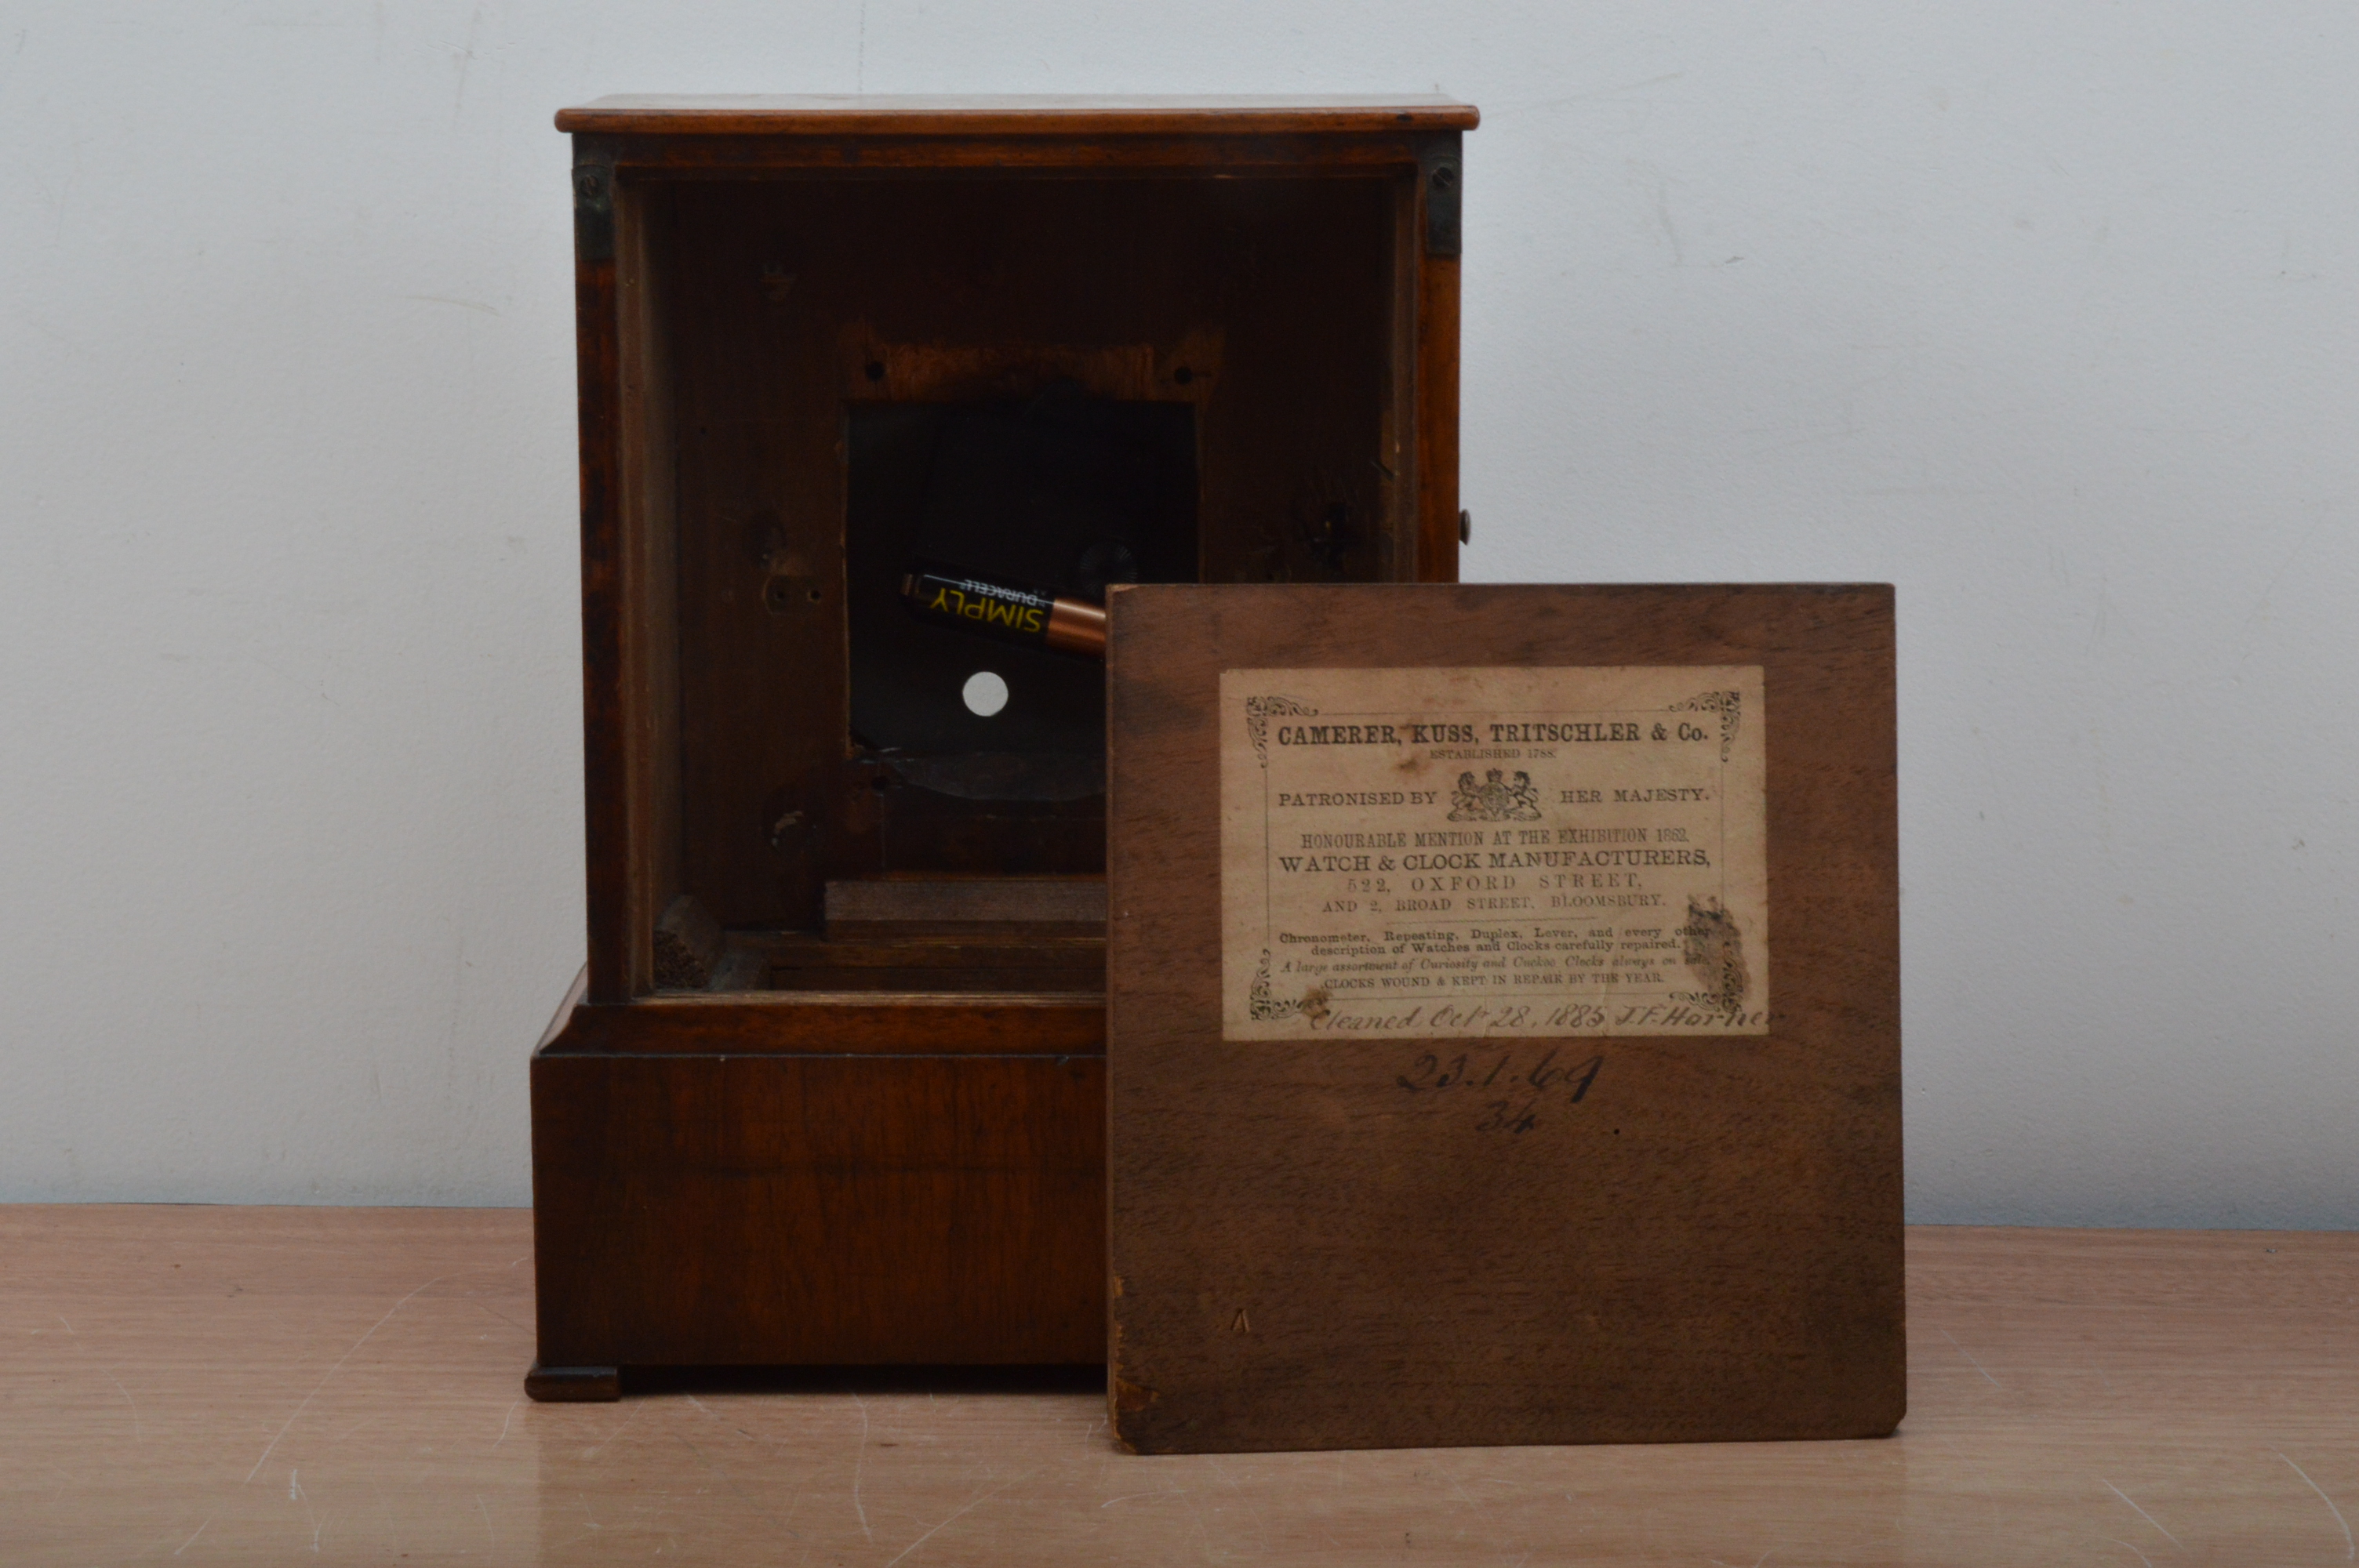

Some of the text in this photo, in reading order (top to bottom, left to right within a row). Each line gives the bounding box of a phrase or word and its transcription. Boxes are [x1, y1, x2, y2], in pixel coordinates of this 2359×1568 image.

[964, 579, 1038, 606] DURACELL
[930, 588, 1044, 633] SIMPLY
[1278, 722, 1709, 746] CAMERER, KUSS, TRITSCHLER & Co.
[1430, 749, 1521, 760] ESTABLISHED
[1278, 791, 1438, 806] PATRONISED BY
[1561, 788, 1710, 804] HER MAJESTY.
[1301, 833, 1407, 849] HONOURABLE
[1414, 831, 1485, 848] MENTION
[1492, 830, 1512, 846] AT
[1518, 829, 1550, 845] THE
[1558, 828, 1648, 845] EXHIBITION
[1278, 849, 1711, 873] WATCH & CLOCK MANUFACTURERS,
[1411, 874, 1516, 892] OXFORD
[1539, 873, 1643, 890] STREET,
[1322, 901, 1358, 913] AND
[1395, 899, 1452, 911] BROAD
[1551, 893, 1667, 909] BLOOMSBURY.
[1534, 927, 1579, 939] Lever,
[1587, 926, 1613, 938] and
[1625, 928, 1662, 939] every
[1675, 926, 1711, 937] other
[1311, 939, 1681, 958] description of Watches and Clocks carefully repaired.
[1280, 961, 1293, 973] A
[1296, 961, 1329, 976] large
[1332, 960, 1398, 973] assortment
[1401, 960, 1416, 975] of
[1419, 958, 1478, 974] Curiosity
[1482, 957, 1507, 969] and
[1513, 956, 1557, 969] Cuckoo
[1565, 954, 1605, 967] Clocks
[1612, 955, 1656, 969] always
[1663, 957, 1677, 966] on
[1324, 971, 1664, 989] CLOCKS WOUND & KEPT IN REPAIR BY THE YEAR.
[1310, 1006, 1422, 1031] Cleaned
